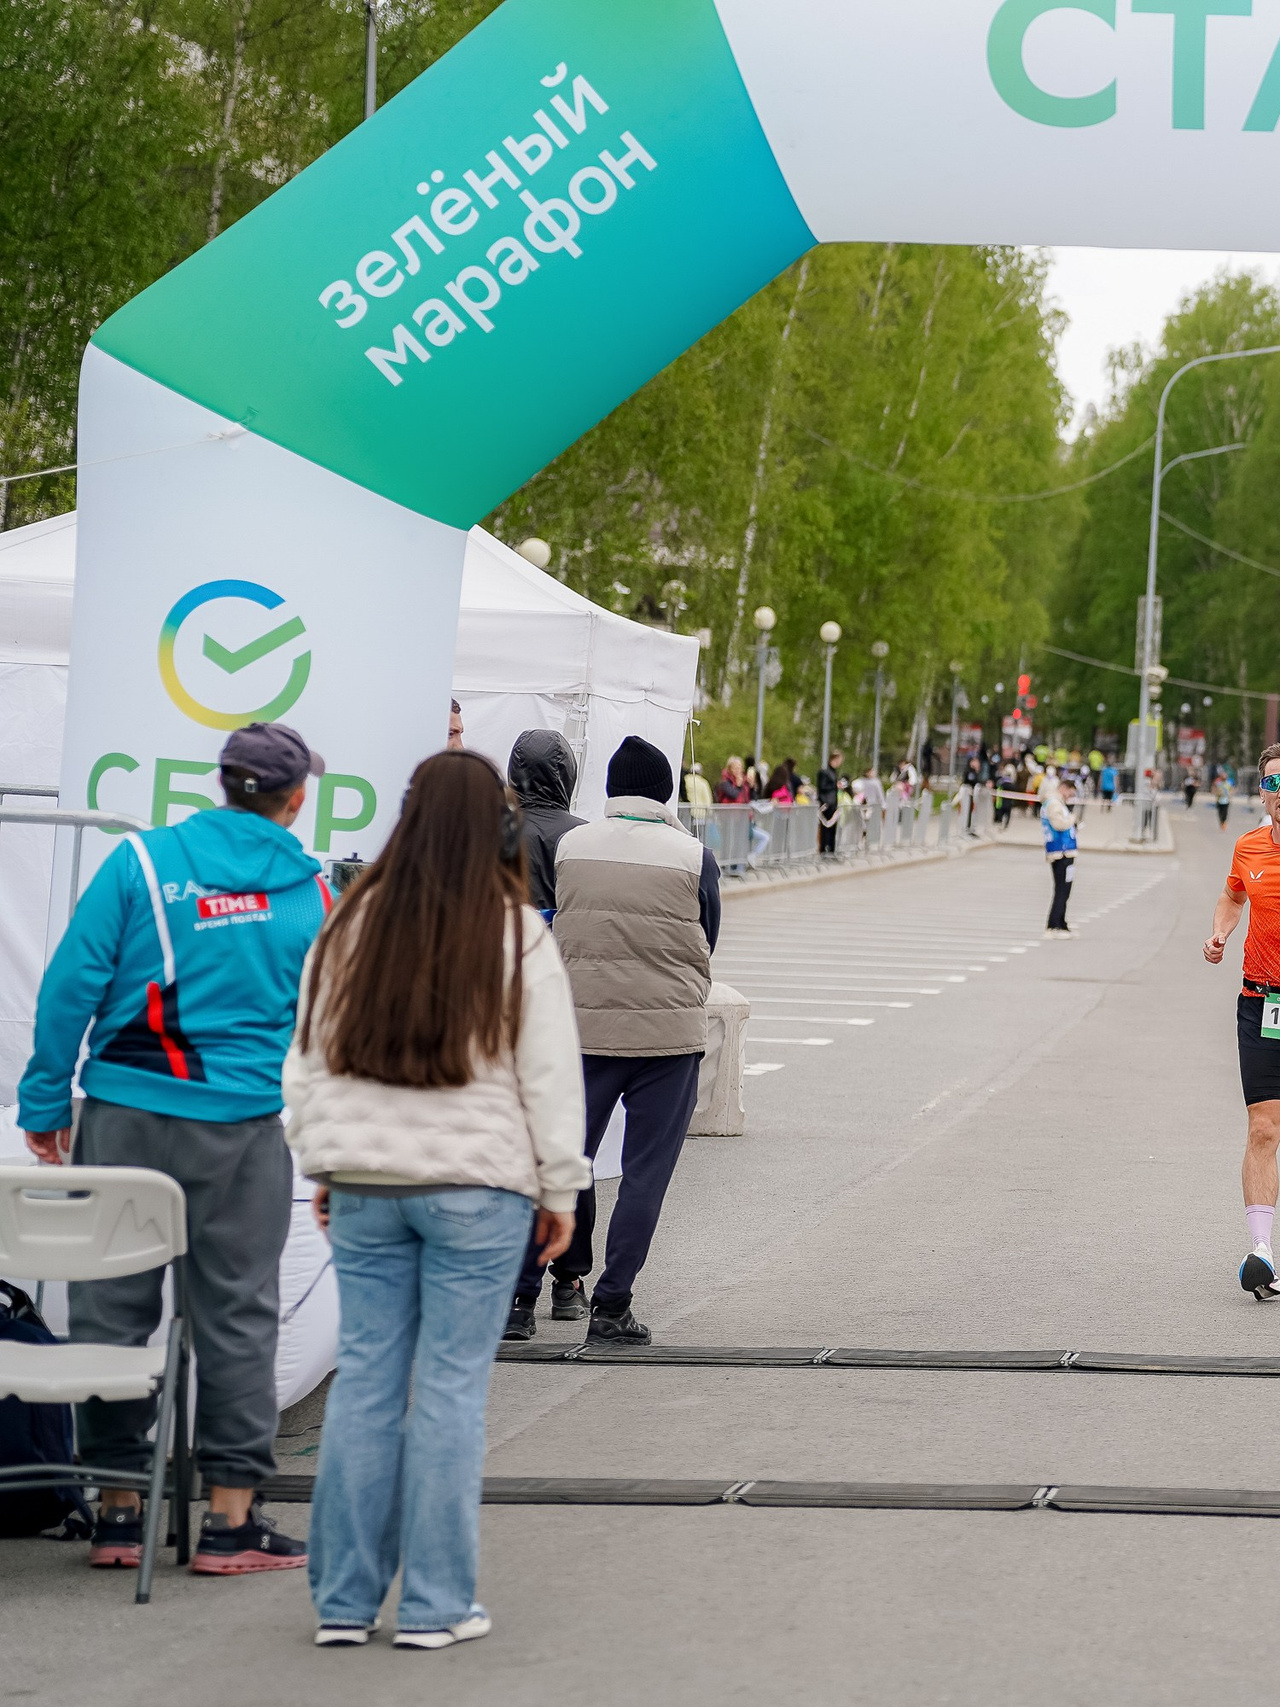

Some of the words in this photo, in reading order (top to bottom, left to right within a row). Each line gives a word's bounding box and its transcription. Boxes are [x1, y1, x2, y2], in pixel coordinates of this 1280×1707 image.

[318, 62, 609, 329] зелёный
[364, 130, 658, 387] марафон
[87, 752, 377, 852] СБР
[162, 879, 221, 904] RA
[205, 894, 258, 916] TIME
